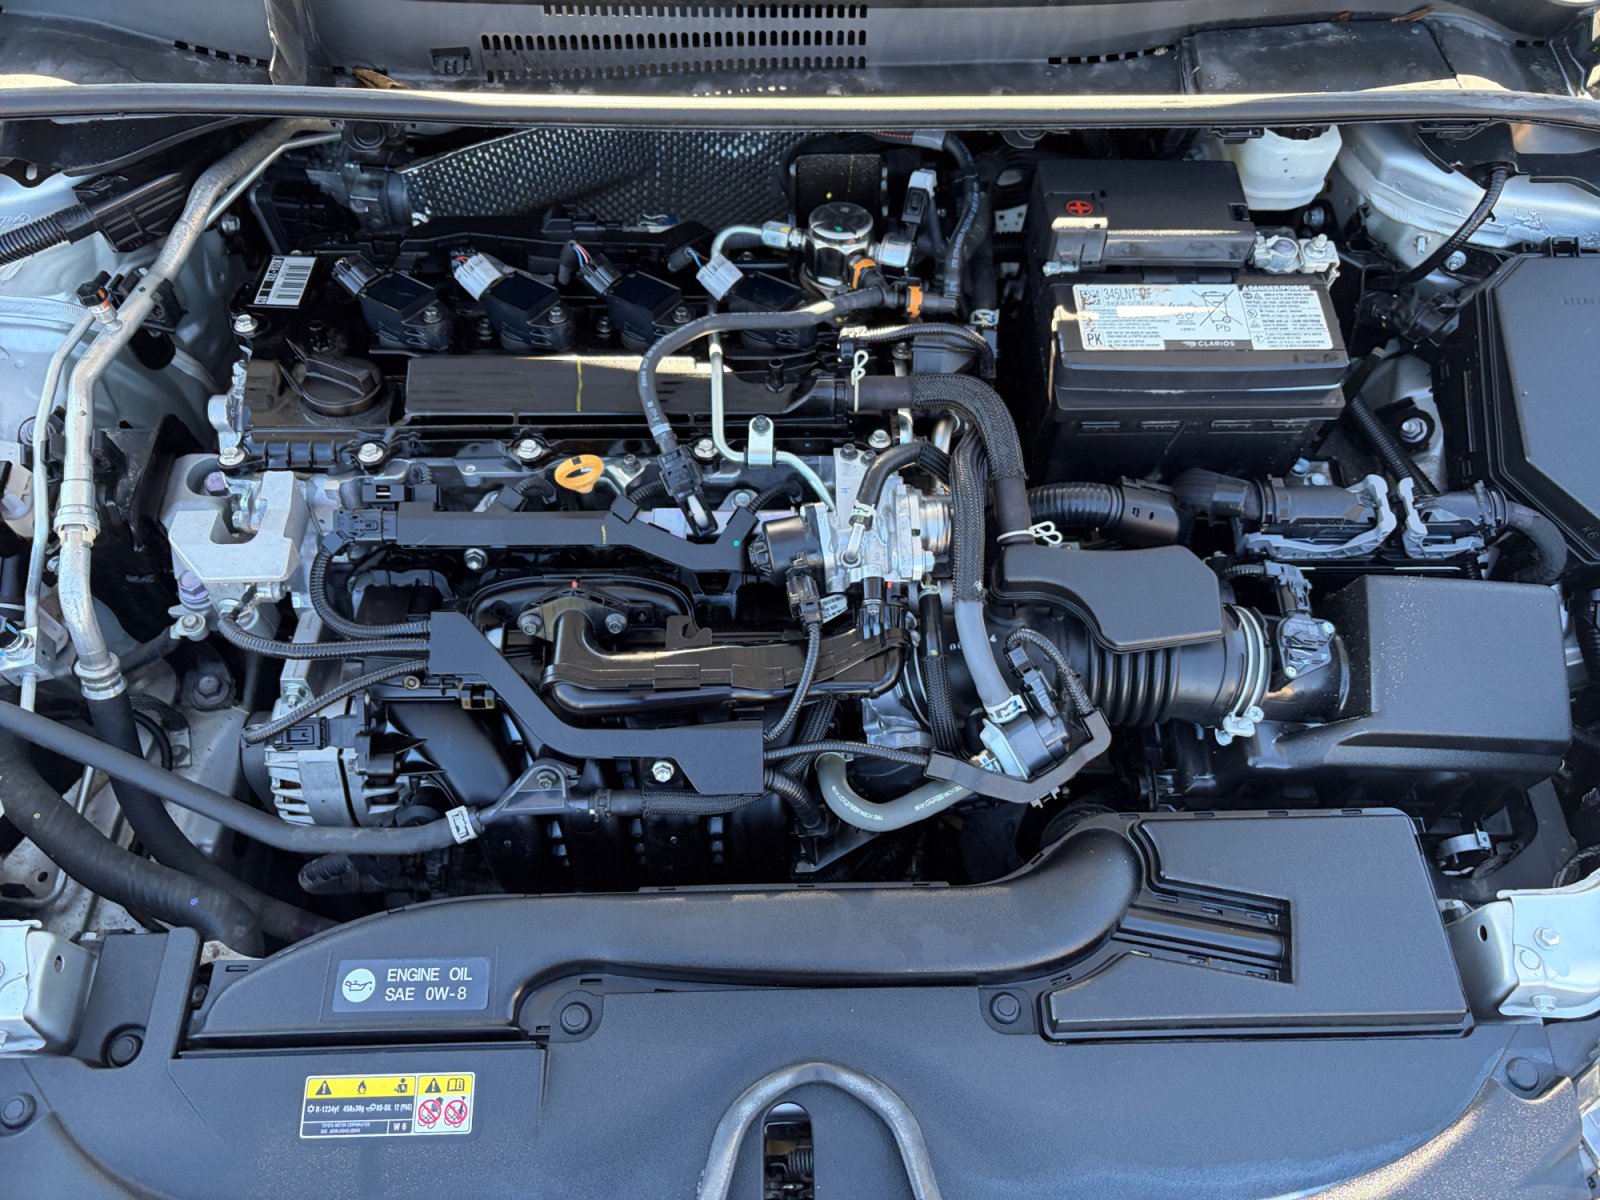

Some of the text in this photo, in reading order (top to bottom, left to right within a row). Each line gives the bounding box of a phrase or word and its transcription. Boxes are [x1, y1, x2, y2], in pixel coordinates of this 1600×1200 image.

[1215, 323, 1231, 332] Pb
[1086, 333, 1103, 346] PK
[387, 967, 472, 982] ENGINE OIL
[384, 987, 467, 1001] SAE 0W-8
[394, 1103, 399, 1111] 12
[400, 1103, 412, 1112] (PAG)
[393, 1123, 401, 1131] W
